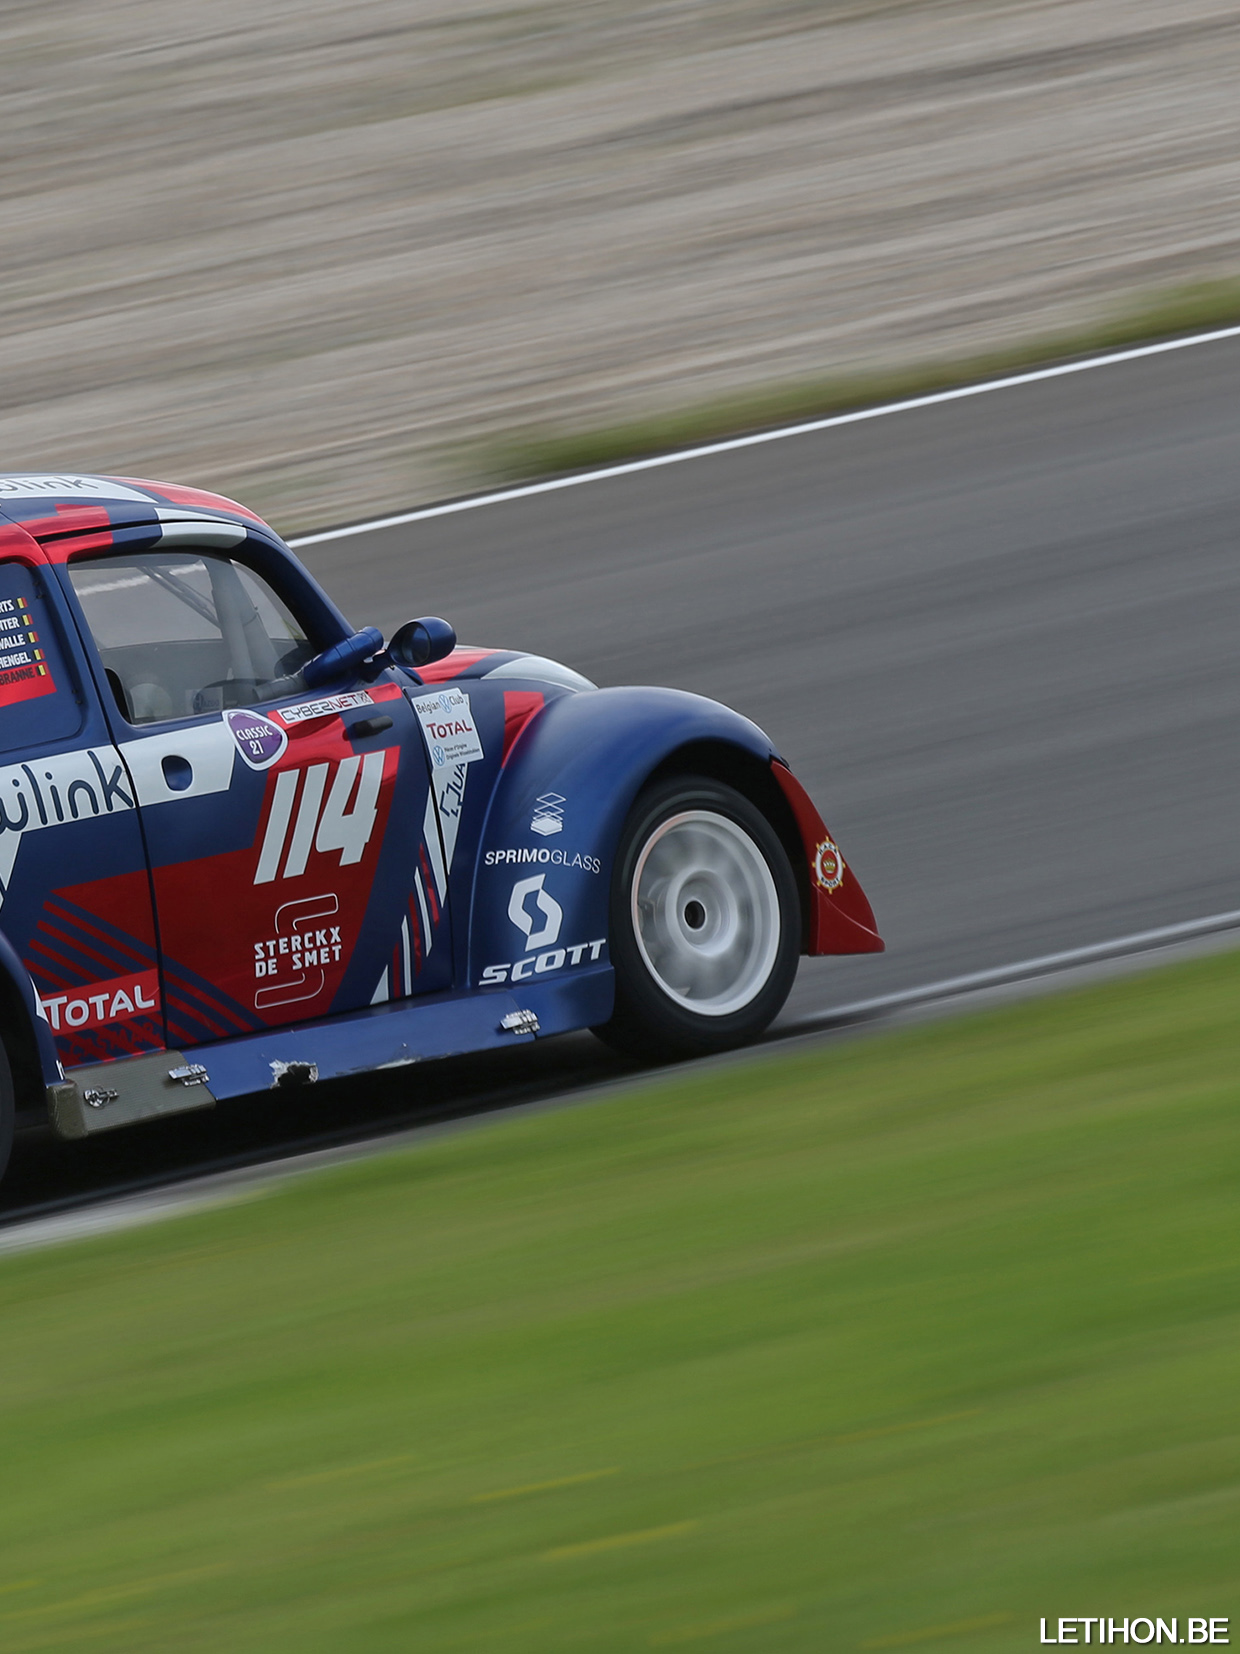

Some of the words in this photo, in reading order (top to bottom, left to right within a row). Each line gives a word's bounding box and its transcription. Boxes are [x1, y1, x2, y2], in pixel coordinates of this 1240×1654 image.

[416, 702, 441, 714] Belgian
[449, 695, 464, 706] Club
[236, 725, 273, 741] CLASSIC
[426, 719, 472, 739] TOTAL
[249, 740, 264, 755] 21
[253, 751, 386, 885] 114
[485, 848, 601, 874] SPRIMOGLASS
[254, 926, 341, 960] STERCKX
[255, 958, 278, 978] DE
[292, 945, 342, 970] SMET
[478, 939, 606, 986] SCOTT
[42, 985, 154, 1029] TOTAL
